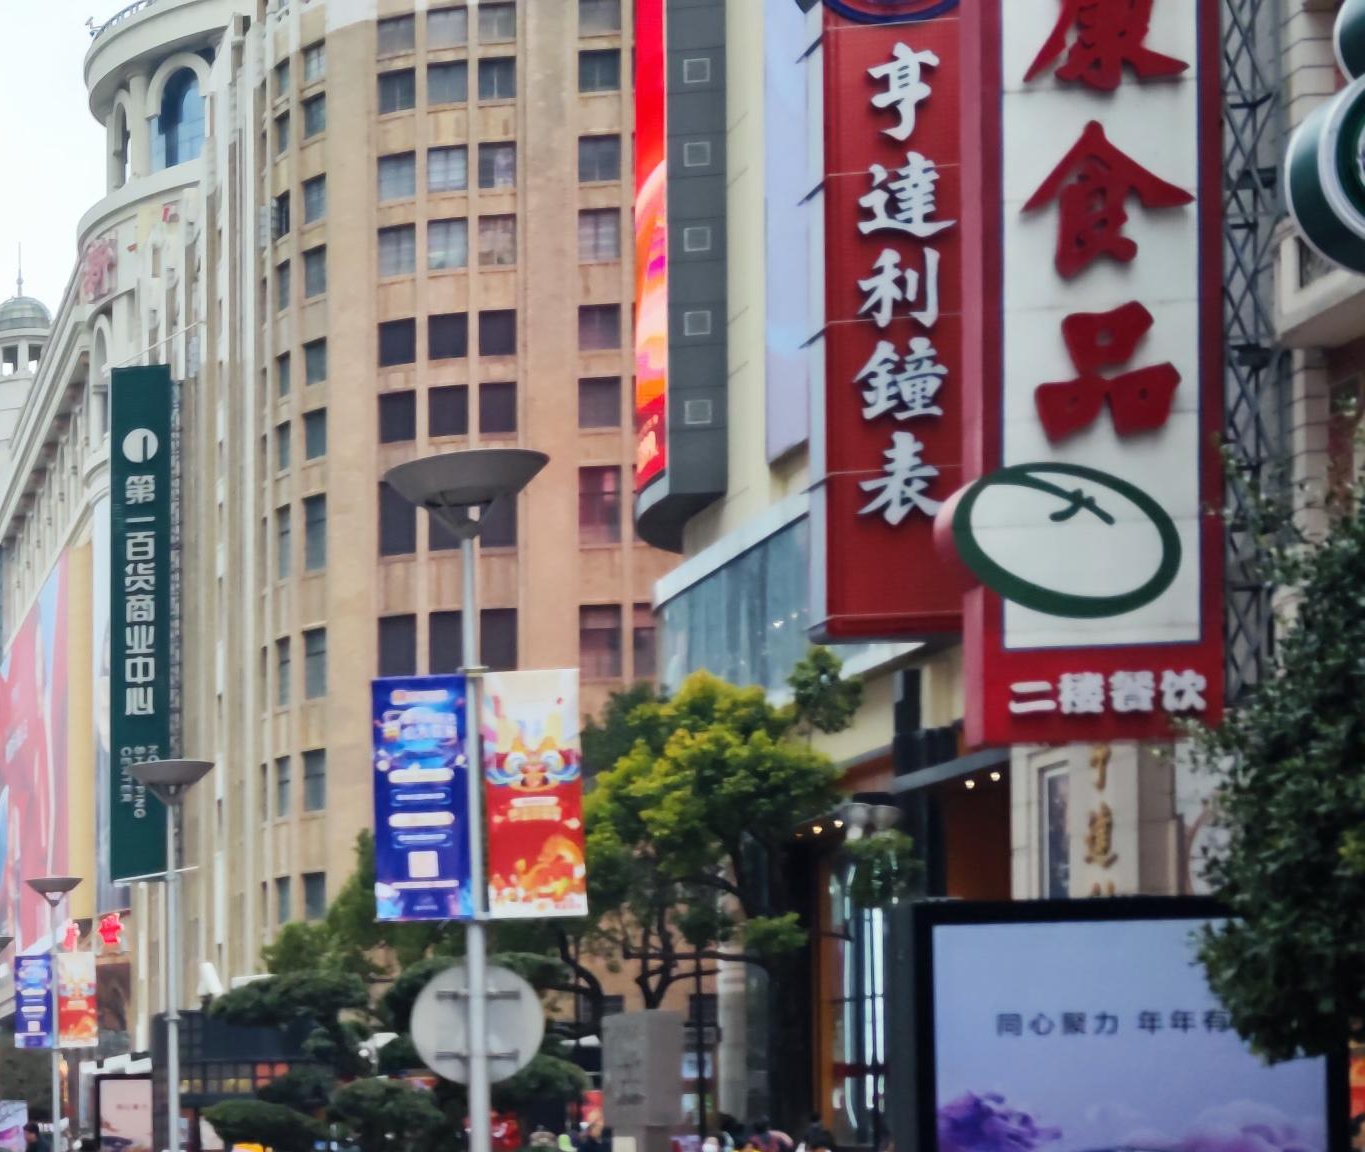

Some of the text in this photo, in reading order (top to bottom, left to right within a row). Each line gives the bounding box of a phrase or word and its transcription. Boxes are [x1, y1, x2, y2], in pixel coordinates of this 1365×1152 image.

[853, 42, 957, 525] 亨達利鐘表
[125, 474, 156, 715] 第一百货商业中心
[996, 1010, 1232, 1036] 同心聚力 年年有
